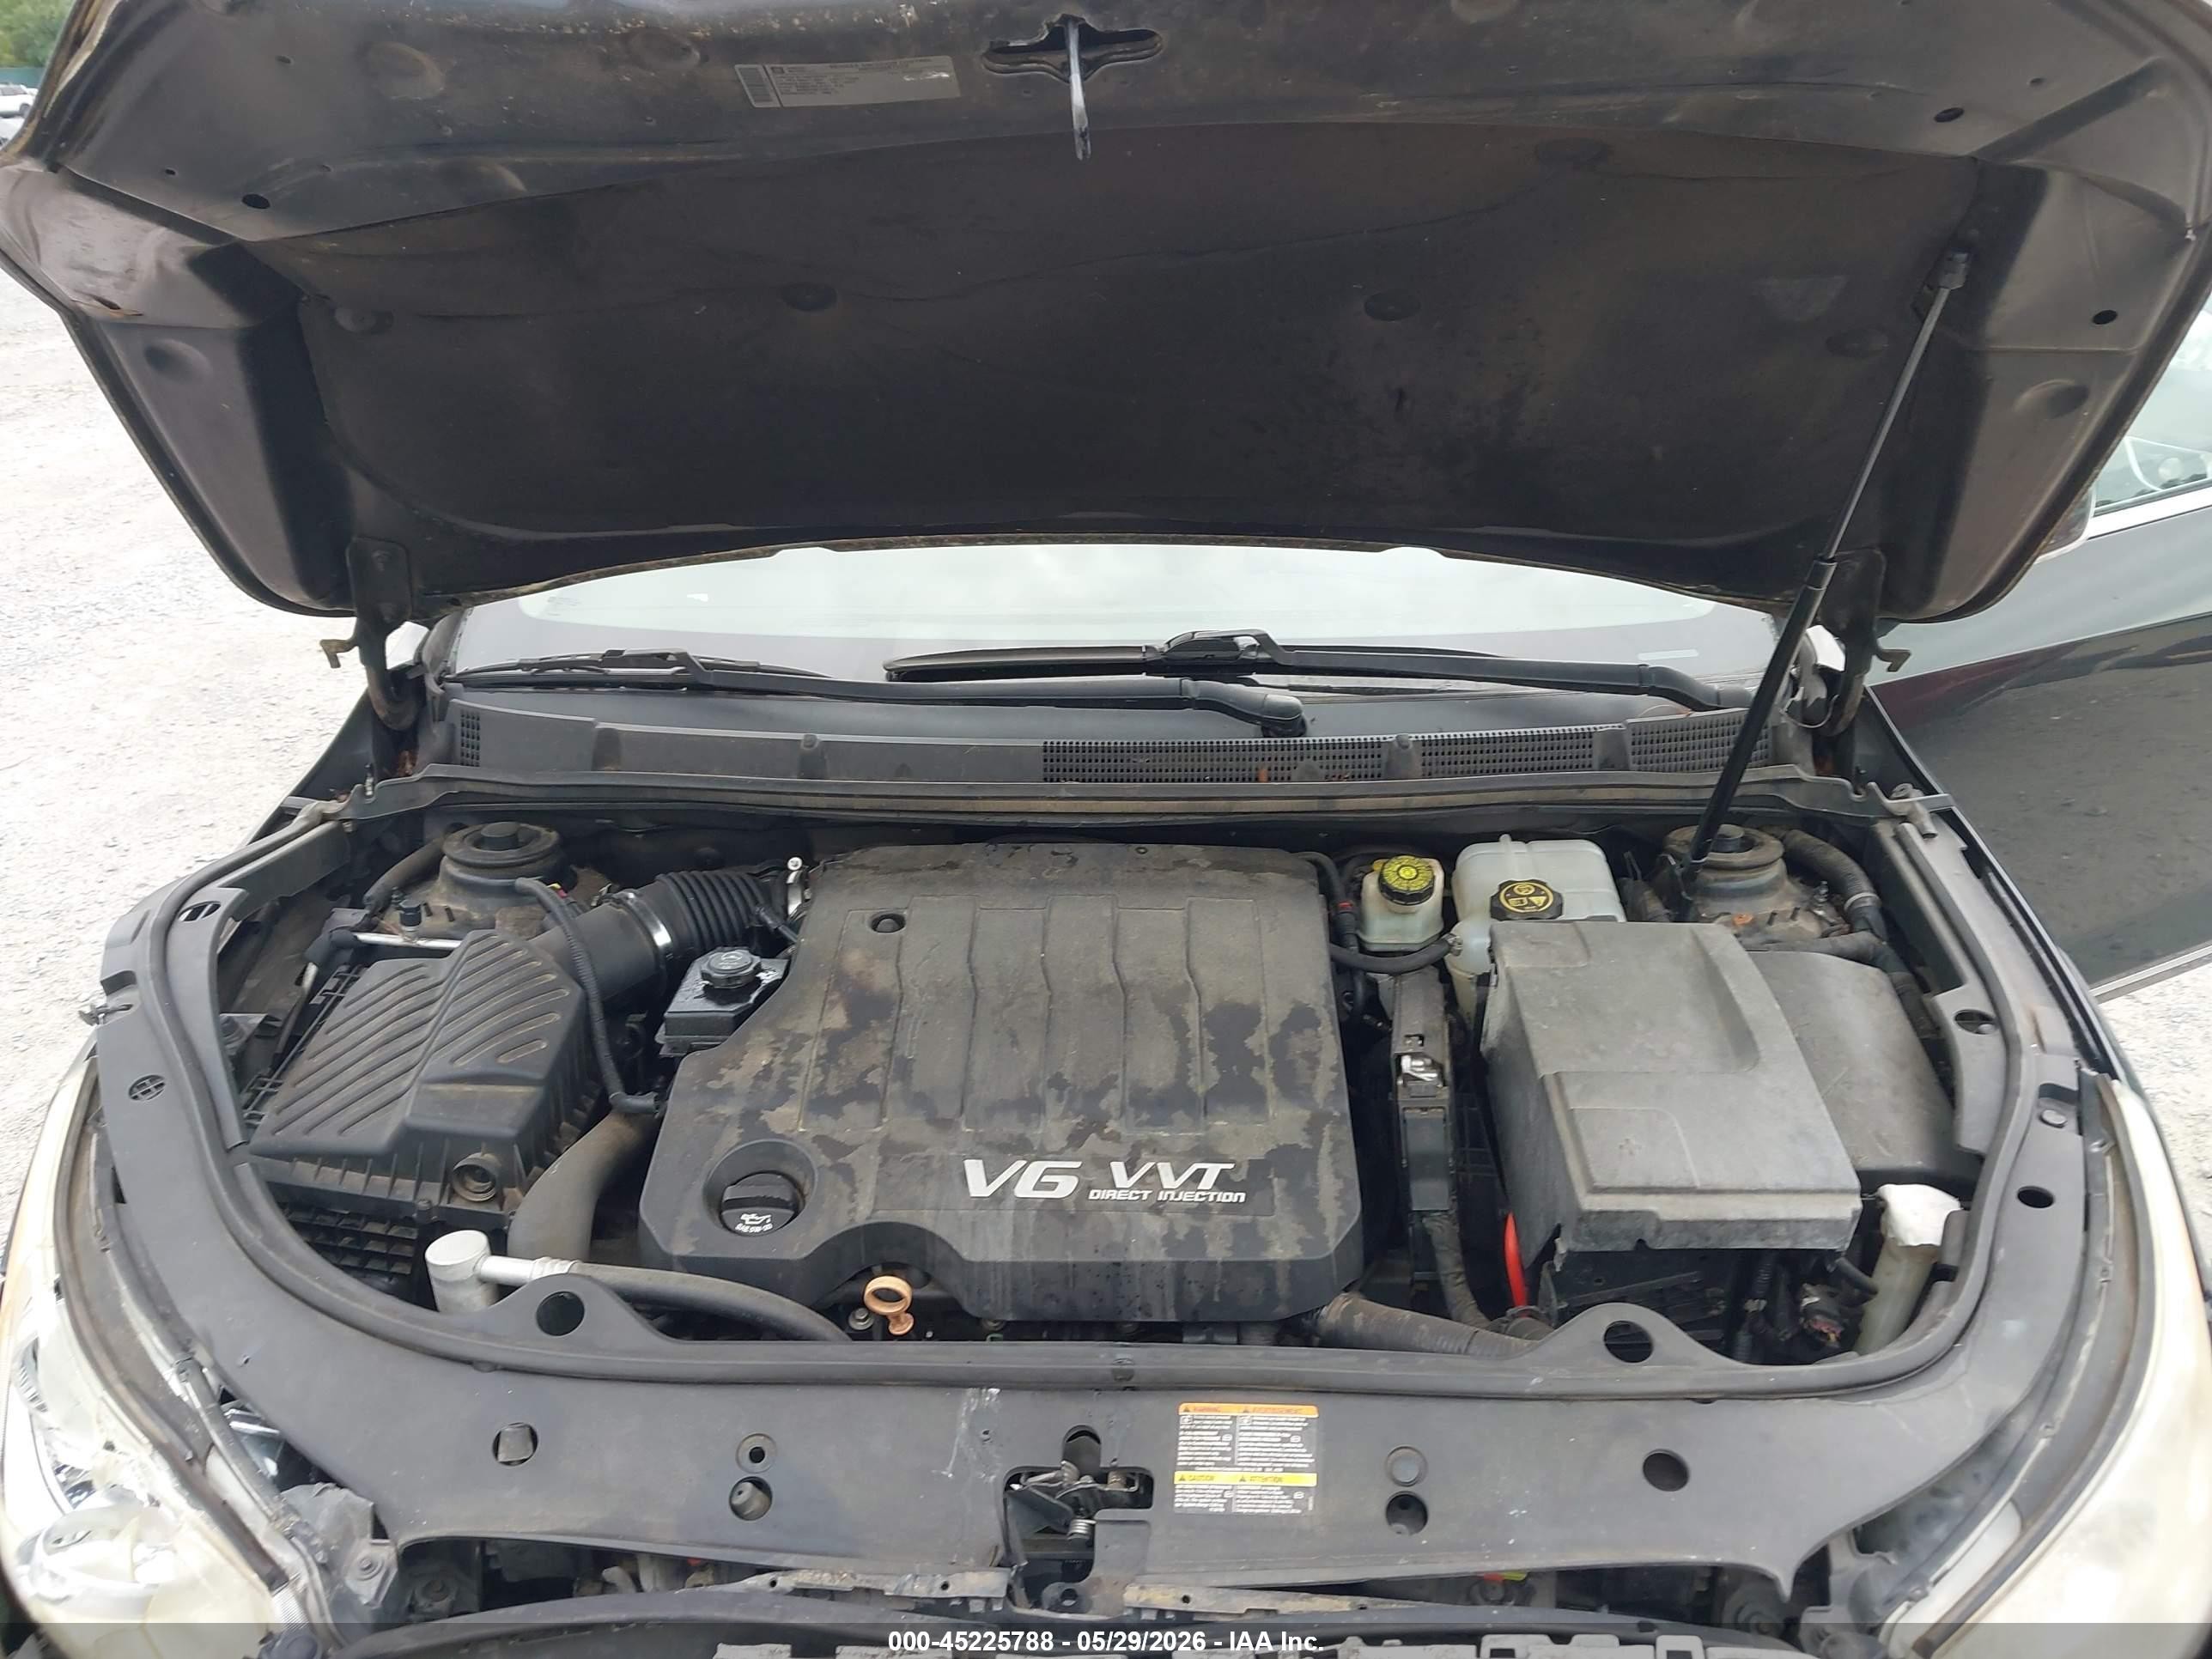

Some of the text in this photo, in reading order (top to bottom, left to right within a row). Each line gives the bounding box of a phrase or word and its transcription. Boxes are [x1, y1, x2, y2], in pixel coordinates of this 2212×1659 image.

[963, 1158, 1236, 1199] V6 VVT
[1088, 1188, 1247, 1203] DIRECT INJECTION
